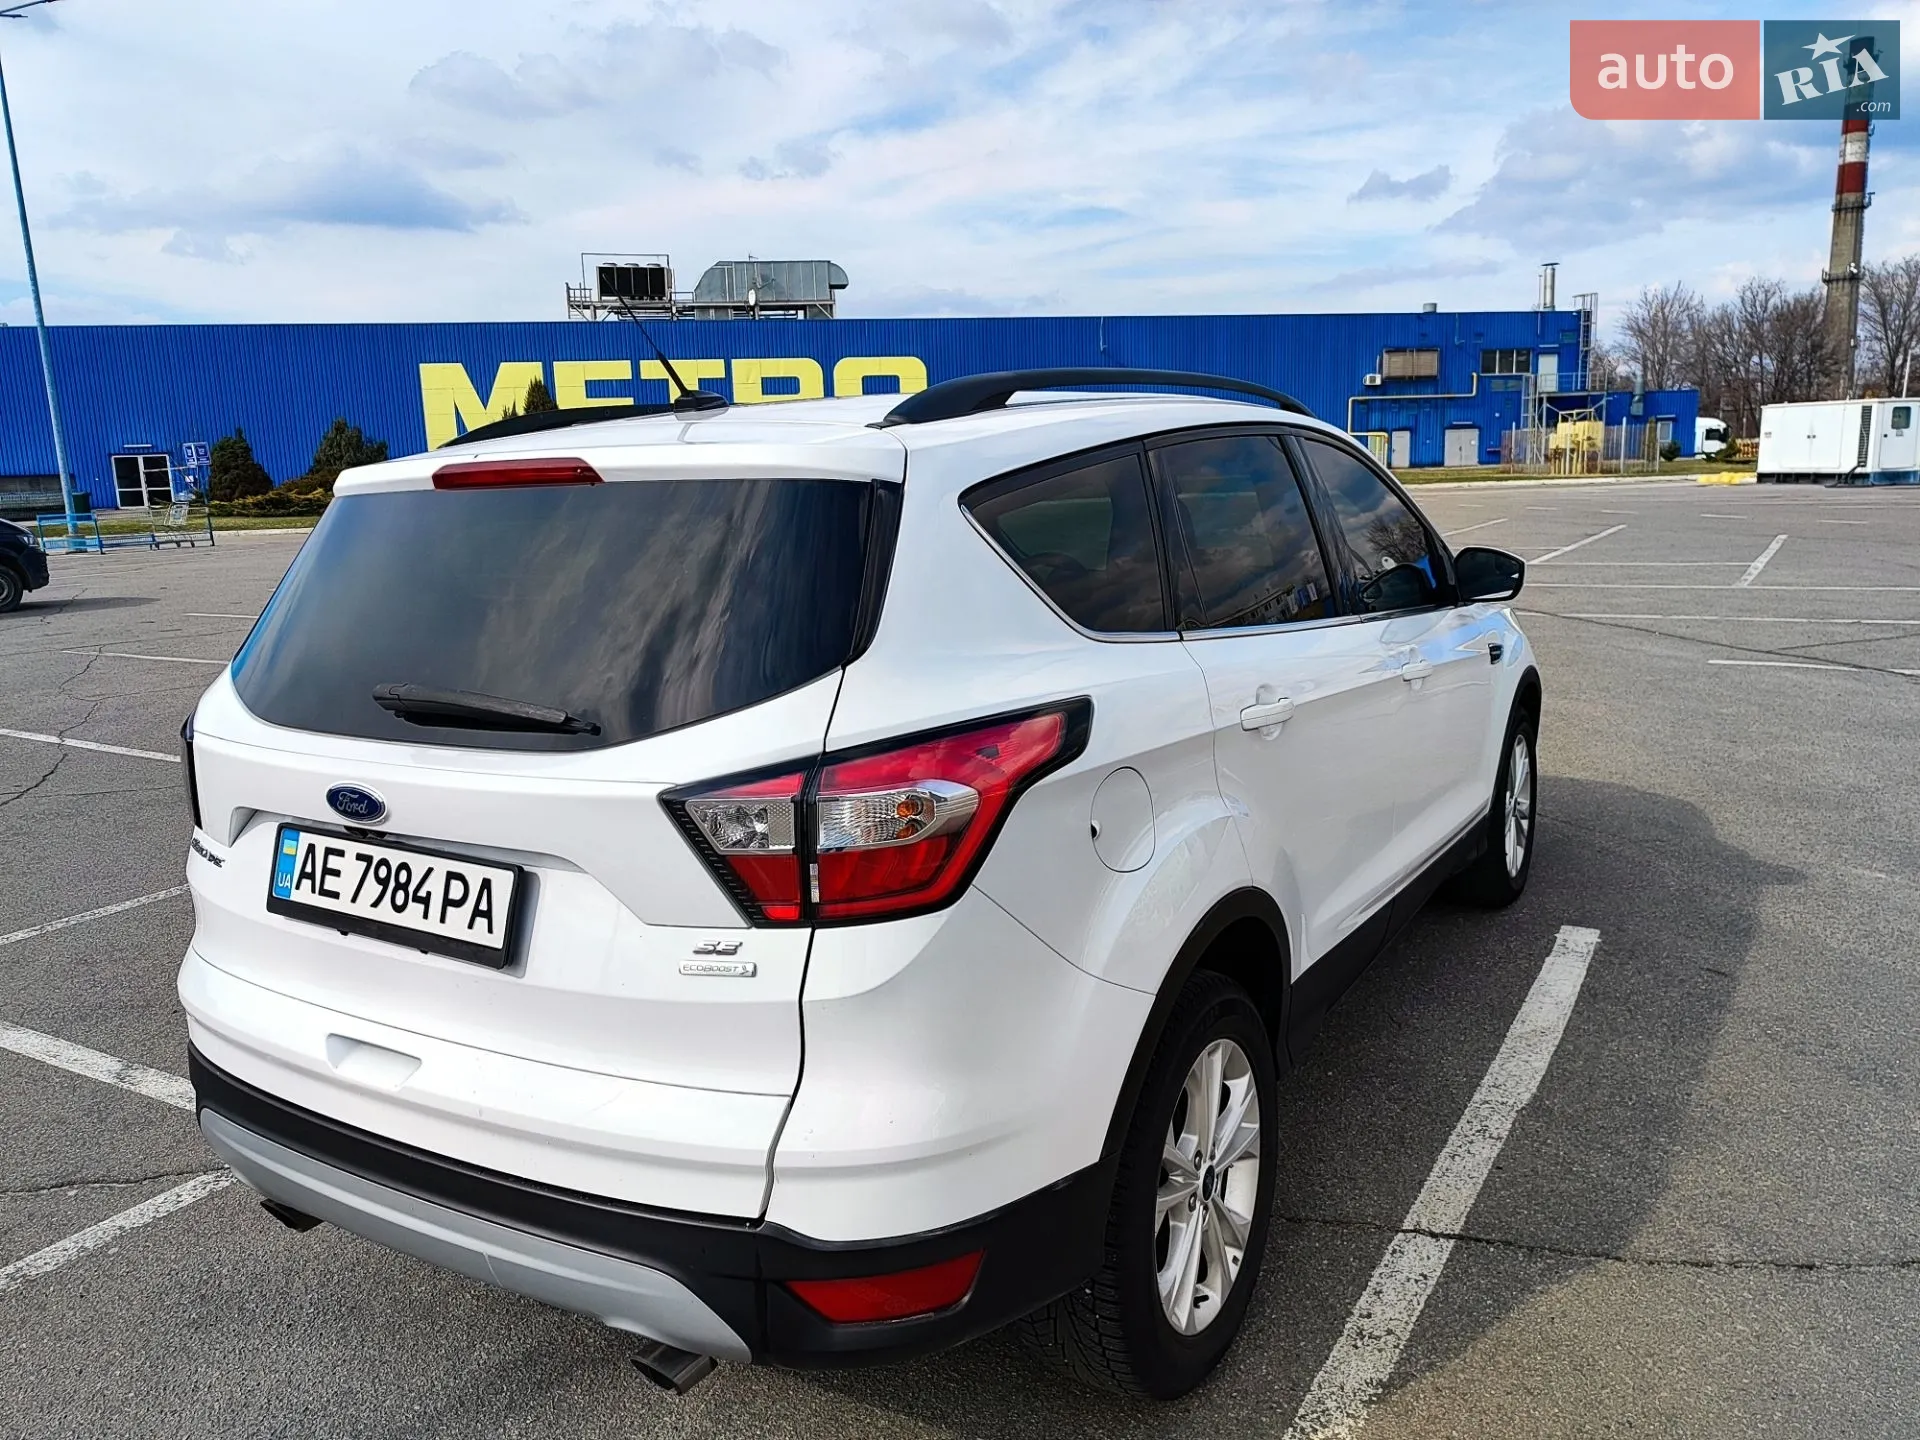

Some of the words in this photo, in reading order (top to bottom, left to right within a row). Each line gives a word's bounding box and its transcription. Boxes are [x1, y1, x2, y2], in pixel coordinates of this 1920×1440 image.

[336, 791, 369, 814] Ford
[277, 871, 292, 889] UA
[295, 842, 346, 901] AE
[350, 852, 435, 921] 7984
[439, 869, 495, 935] PA
[692, 940, 744, 956] SE
[682, 963, 740, 973] ECOBOOST
